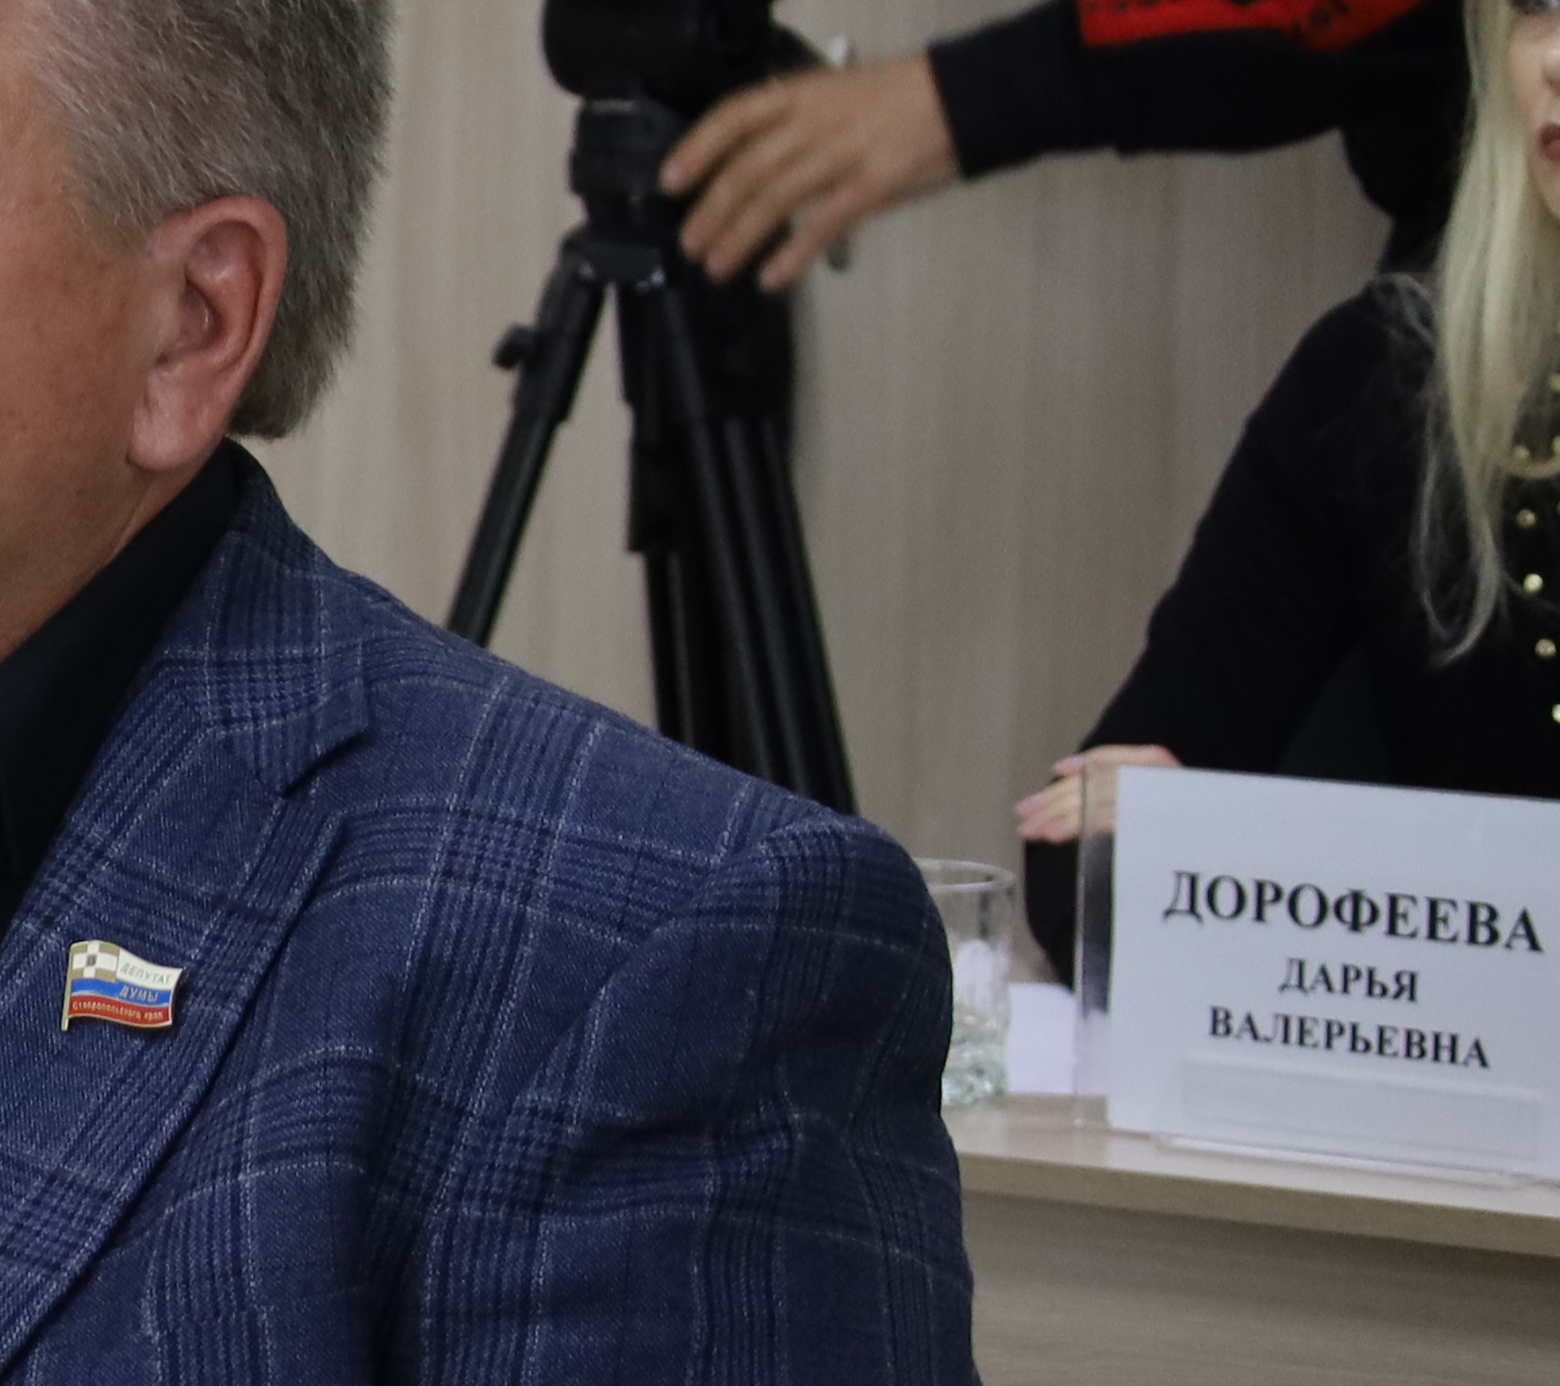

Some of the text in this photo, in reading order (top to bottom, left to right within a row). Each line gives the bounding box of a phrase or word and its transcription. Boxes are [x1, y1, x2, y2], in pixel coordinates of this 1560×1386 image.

[1162, 871, 1541, 953] ДОРОФЕЕВА
[1276, 958, 1418, 1004] ДАРЬЯ
[1206, 1005, 1489, 1071] ВАЛЕРЬЕВНА
